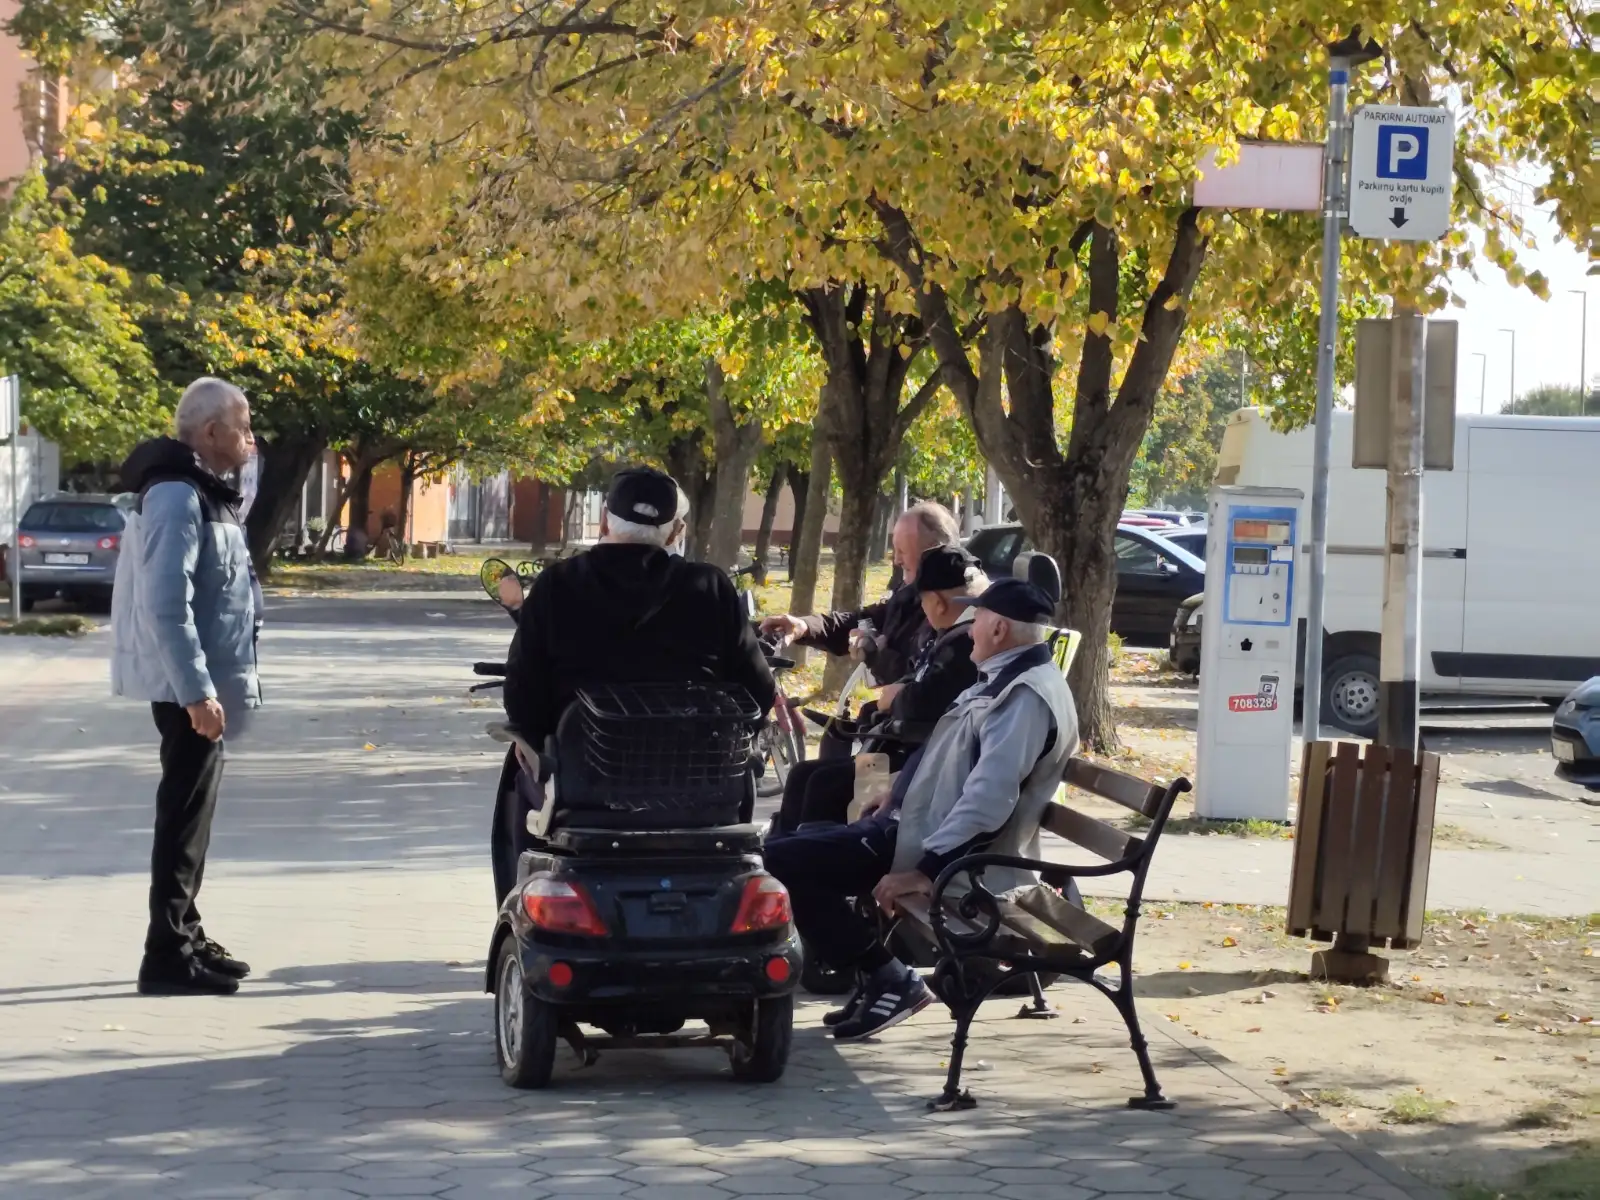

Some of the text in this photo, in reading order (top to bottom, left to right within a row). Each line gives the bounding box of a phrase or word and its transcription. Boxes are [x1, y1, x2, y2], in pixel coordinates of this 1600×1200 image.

[1364, 111, 1446, 124] PARKIRNI AUTOMAT
[1389, 133, 1420, 173] P
[1397, 182, 1419, 193] kartu
[1389, 194, 1413, 205] ovdje
[1233, 697, 1273, 709] 708328
